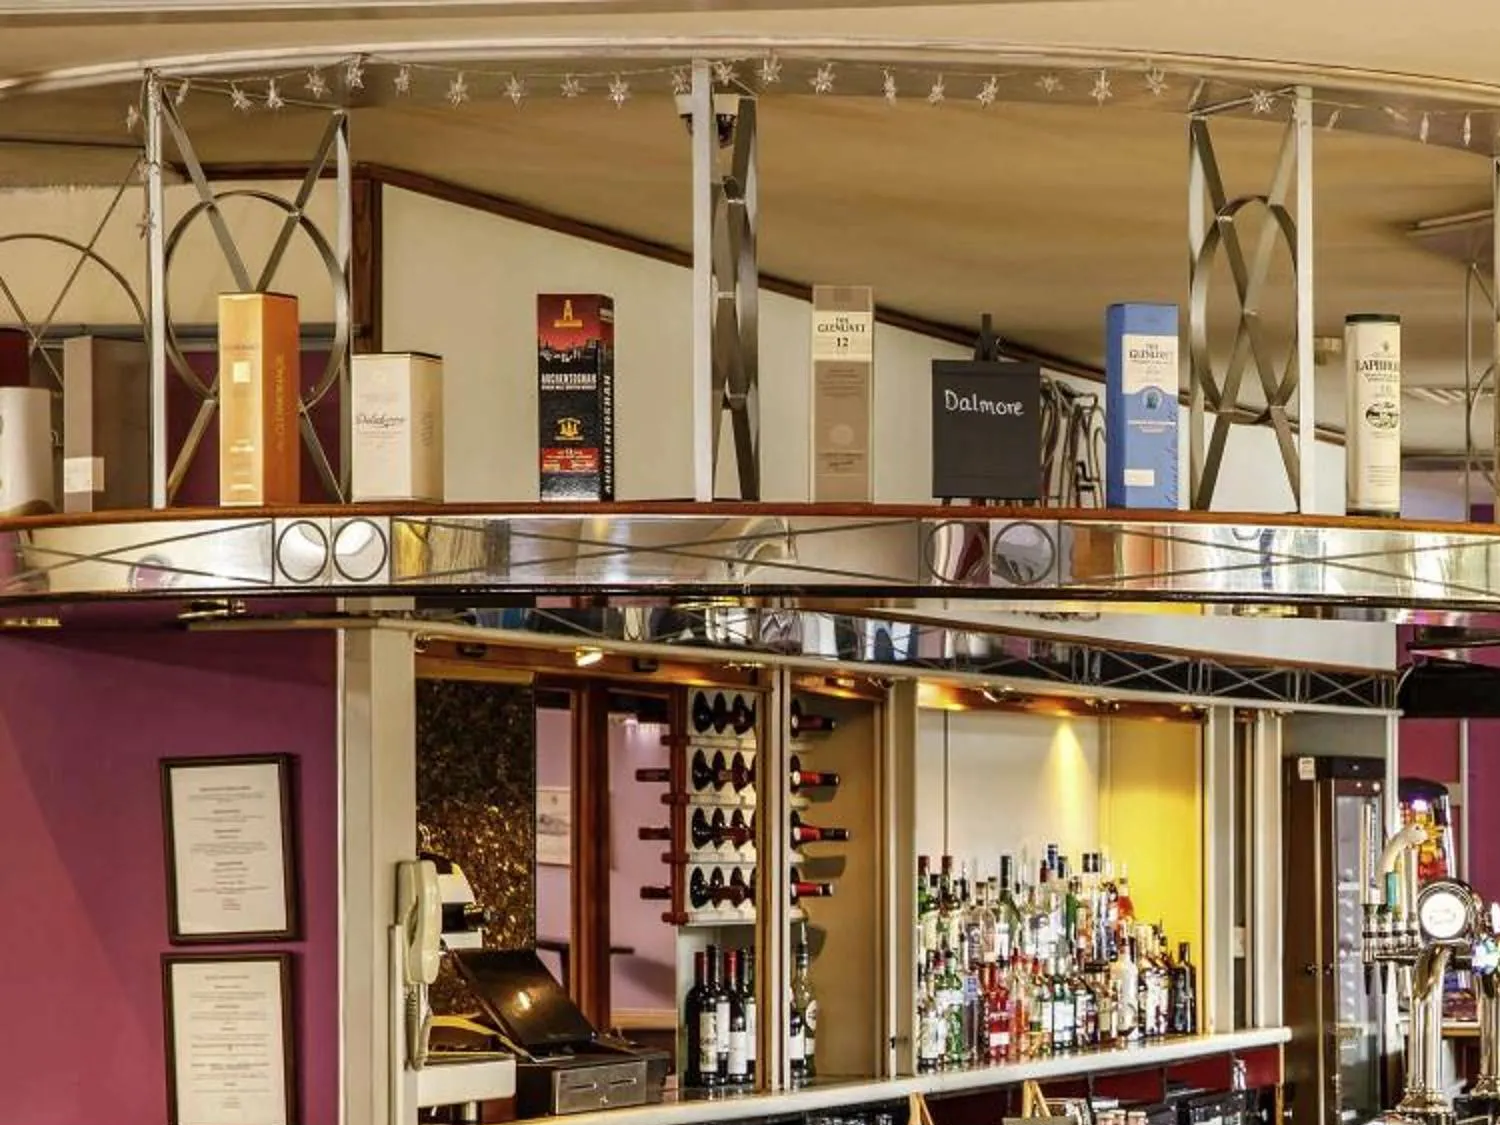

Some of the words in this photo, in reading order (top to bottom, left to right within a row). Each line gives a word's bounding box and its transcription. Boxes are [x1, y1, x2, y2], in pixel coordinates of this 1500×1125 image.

[837, 337, 849, 347] 12
[944, 388, 1025, 417] Dalmore
[603, 373, 612, 495] AUCHENTOSHAN
